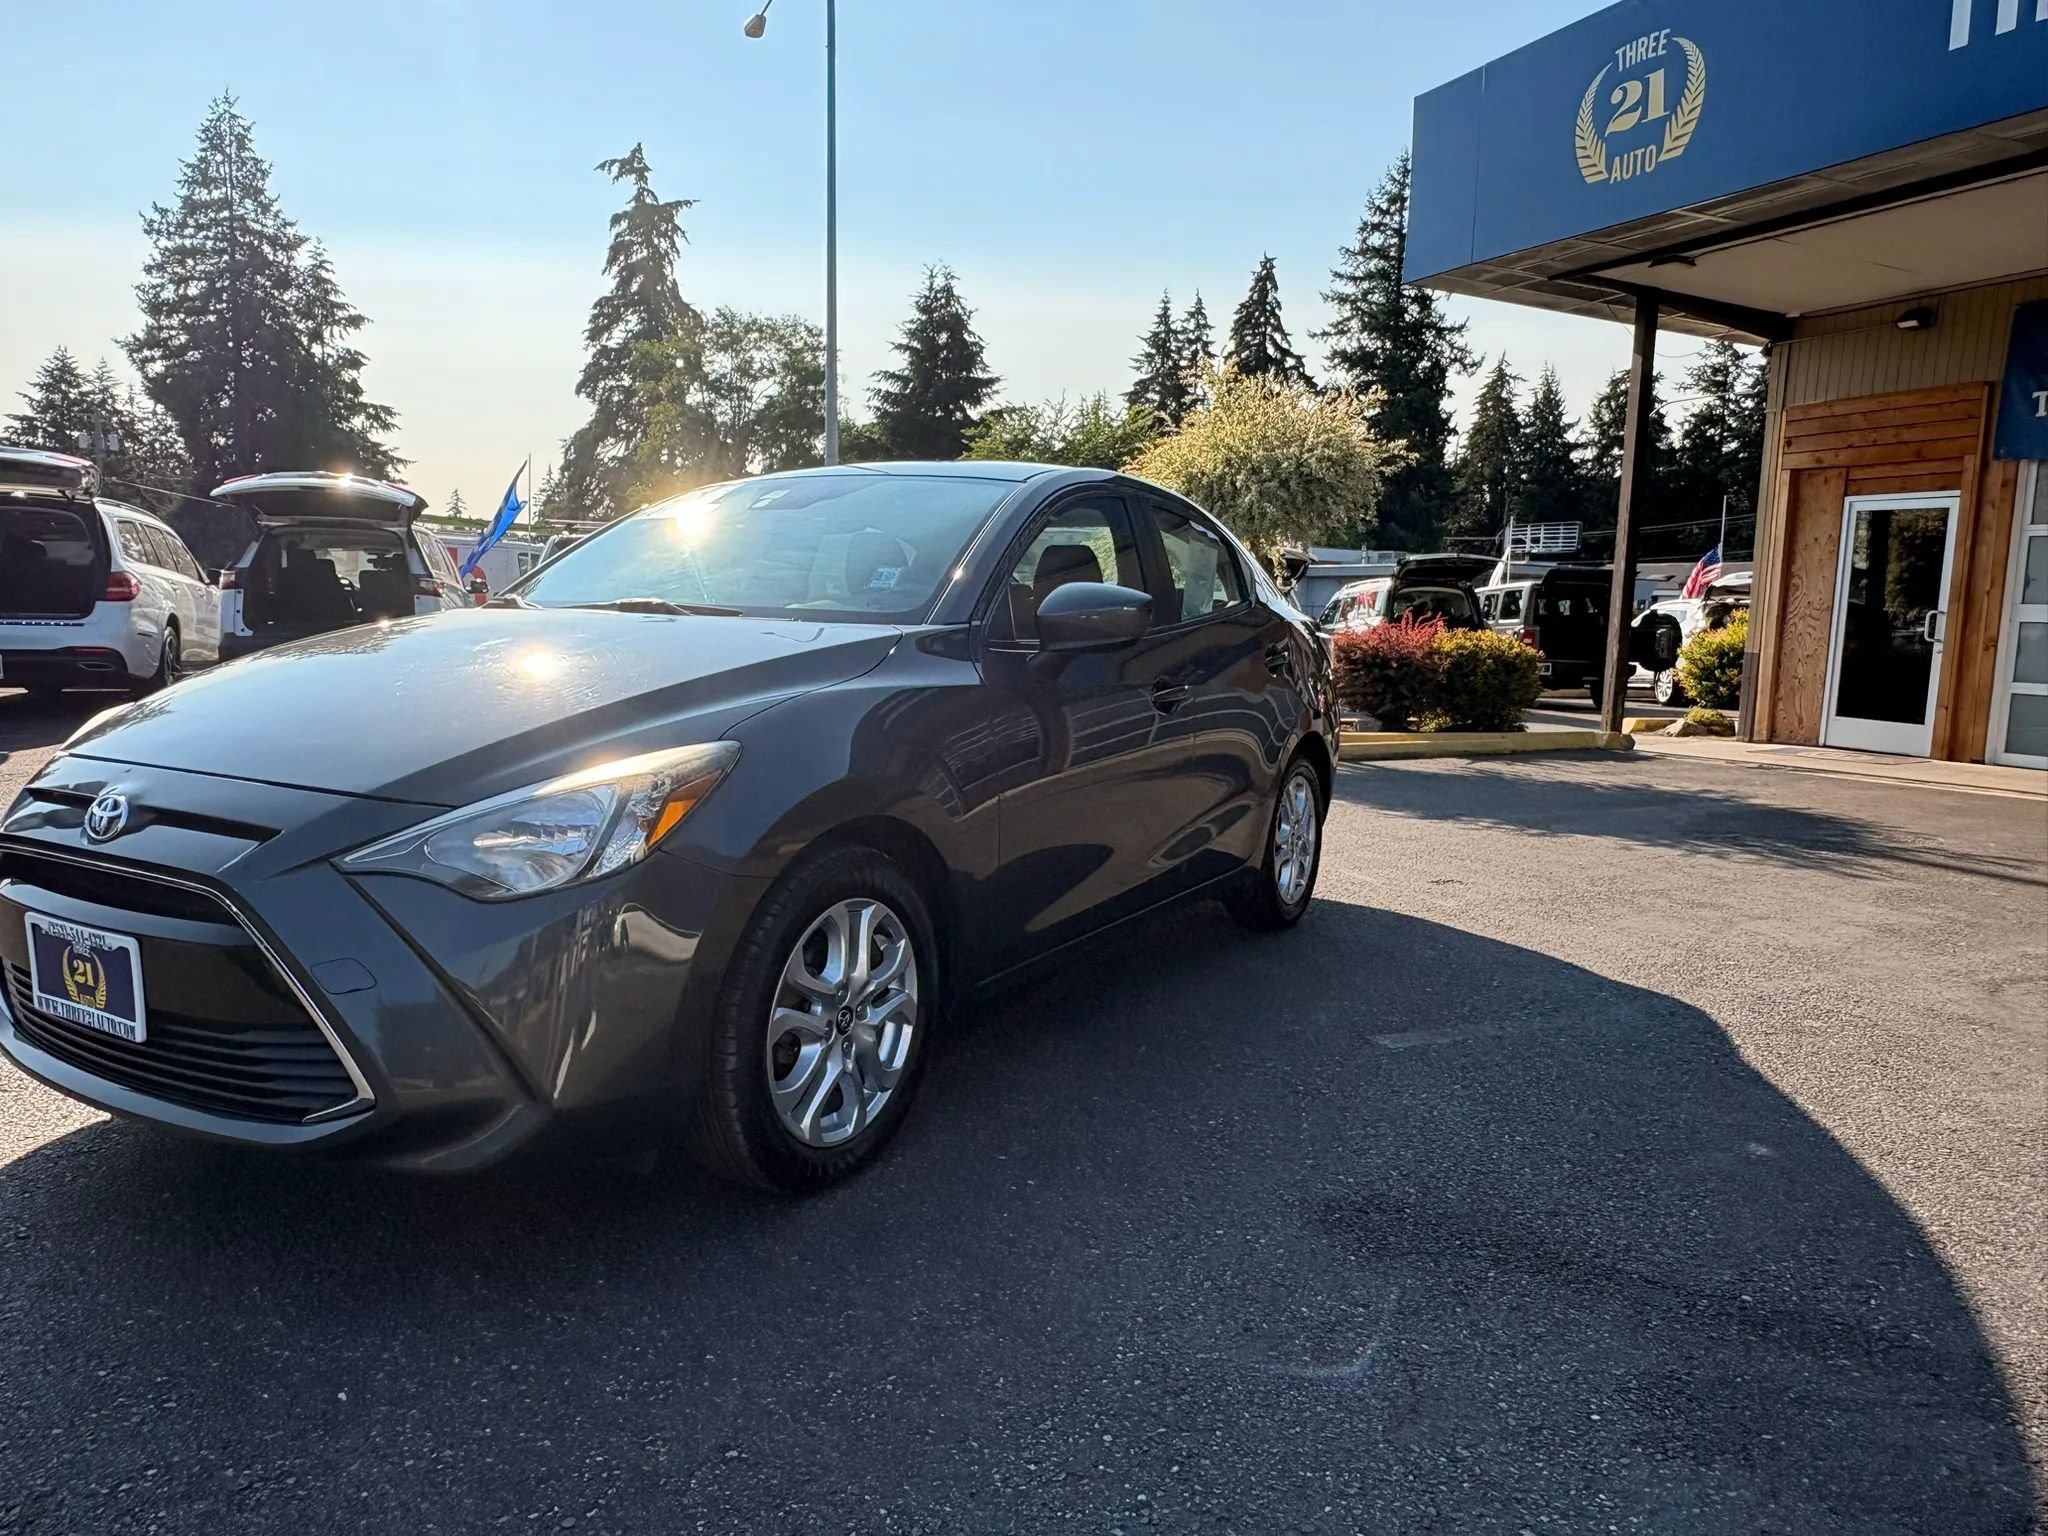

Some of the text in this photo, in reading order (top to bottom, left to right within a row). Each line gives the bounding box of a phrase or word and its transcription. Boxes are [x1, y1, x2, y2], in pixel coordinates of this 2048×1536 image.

[1615, 28, 1671, 72] THREE
[1604, 68, 1670, 138] 21
[1609, 144, 1658, 184] AUTO
[73, 959, 95, 987] 21
